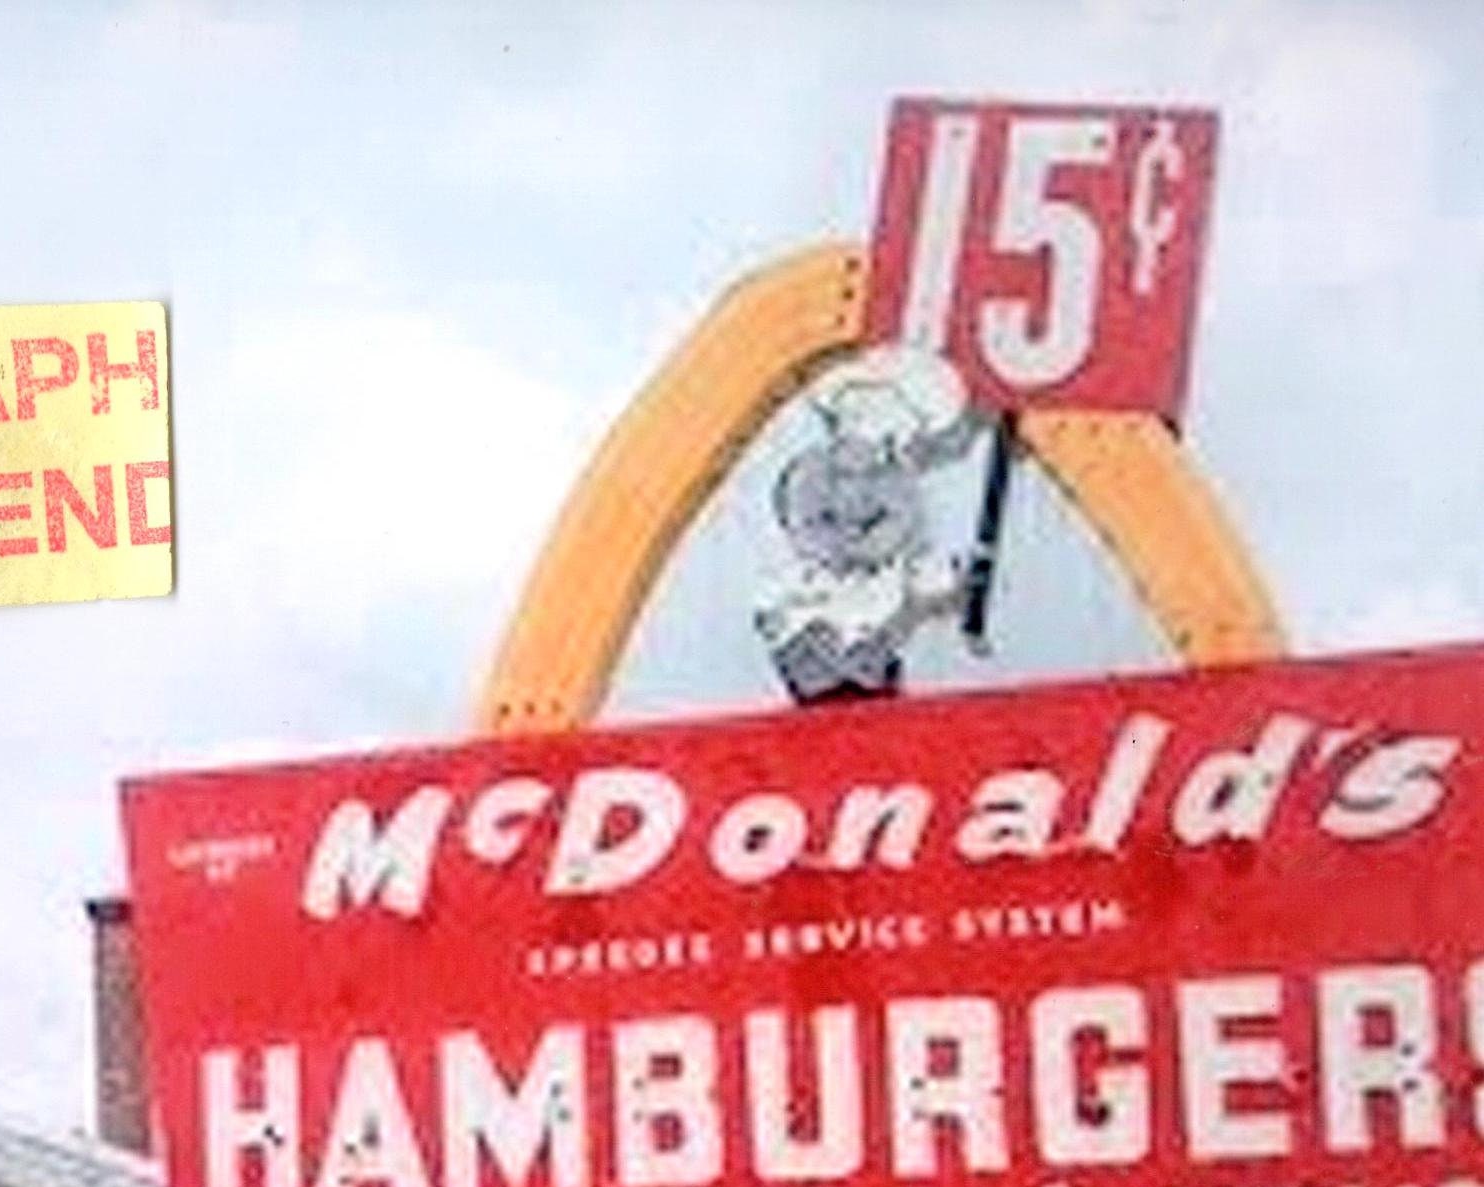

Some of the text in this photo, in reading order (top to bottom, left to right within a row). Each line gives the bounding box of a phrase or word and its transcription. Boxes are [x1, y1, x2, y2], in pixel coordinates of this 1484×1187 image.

[301, 708, 1464, 921] McDonald's
[743, 914, 930, 960] SERVICE
[951, 898, 1128, 942] SYSTEM
